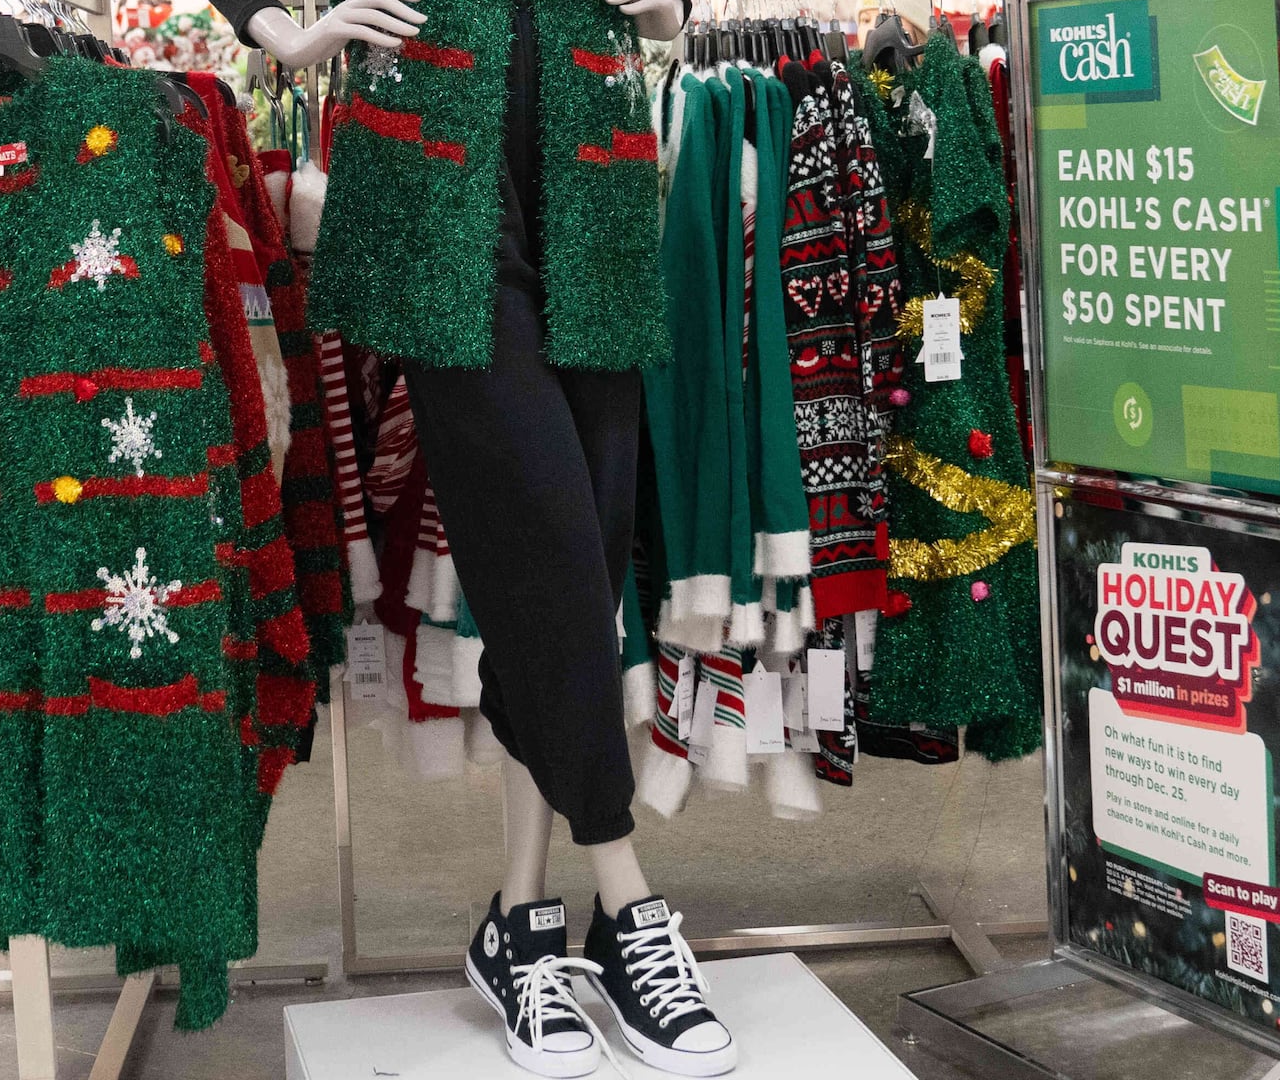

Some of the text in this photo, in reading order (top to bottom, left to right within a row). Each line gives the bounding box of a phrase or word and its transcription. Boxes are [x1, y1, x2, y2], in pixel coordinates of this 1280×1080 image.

[1050, 24, 1107, 43] KOHL'S
[1058, 144, 1195, 185] EARN $15
[1059, 196, 1162, 231] KOHL'S
[1060, 243, 1233, 282] FOR EVERY
[1062, 288, 1226, 333] $50 SPENT
[1063, 335, 1073, 343] Not
[1138, 341, 1149, 350] See
[1133, 552, 1199, 573] KOHL'S
[1103, 572, 1237, 617] HOLIDAY
[1100, 609, 1241, 671] QUEST
[1117, 676, 1229, 709] $1 million in prizes
[1104, 724, 1223, 773] Oh what fun it is to find
[1105, 746, 1240, 801] new ways to win every day
[1105, 764, 1188, 802] through Dec. 25.
[1106, 790, 1240, 848] Play in store and online for a daily
[1107, 807, 1252, 867] chance to win Kohl's Cash and more.
[1207, 878, 1278, 910] Scan to play
